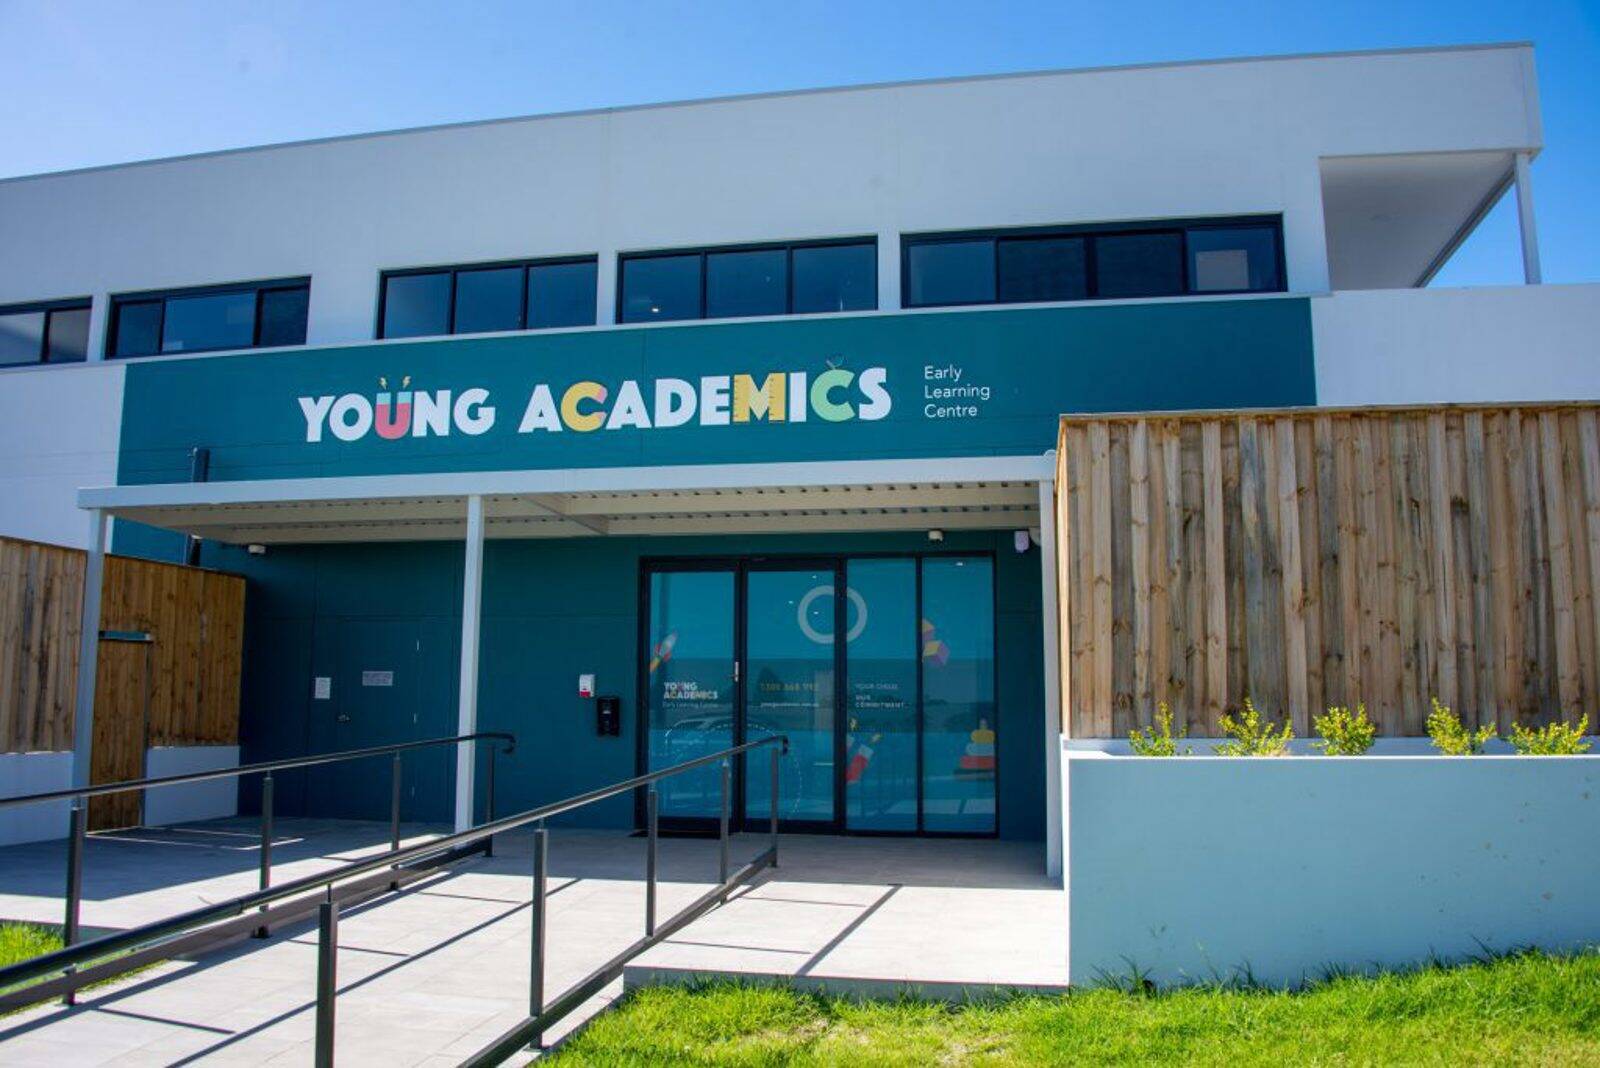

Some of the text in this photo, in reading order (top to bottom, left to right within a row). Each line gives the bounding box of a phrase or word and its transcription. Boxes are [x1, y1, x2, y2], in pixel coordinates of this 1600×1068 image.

[924, 364, 962, 382] Early
[924, 383, 990, 401] Learning
[298, 366, 892, 443] YOUNG ACADEMICS
[924, 403, 978, 418] Centre
